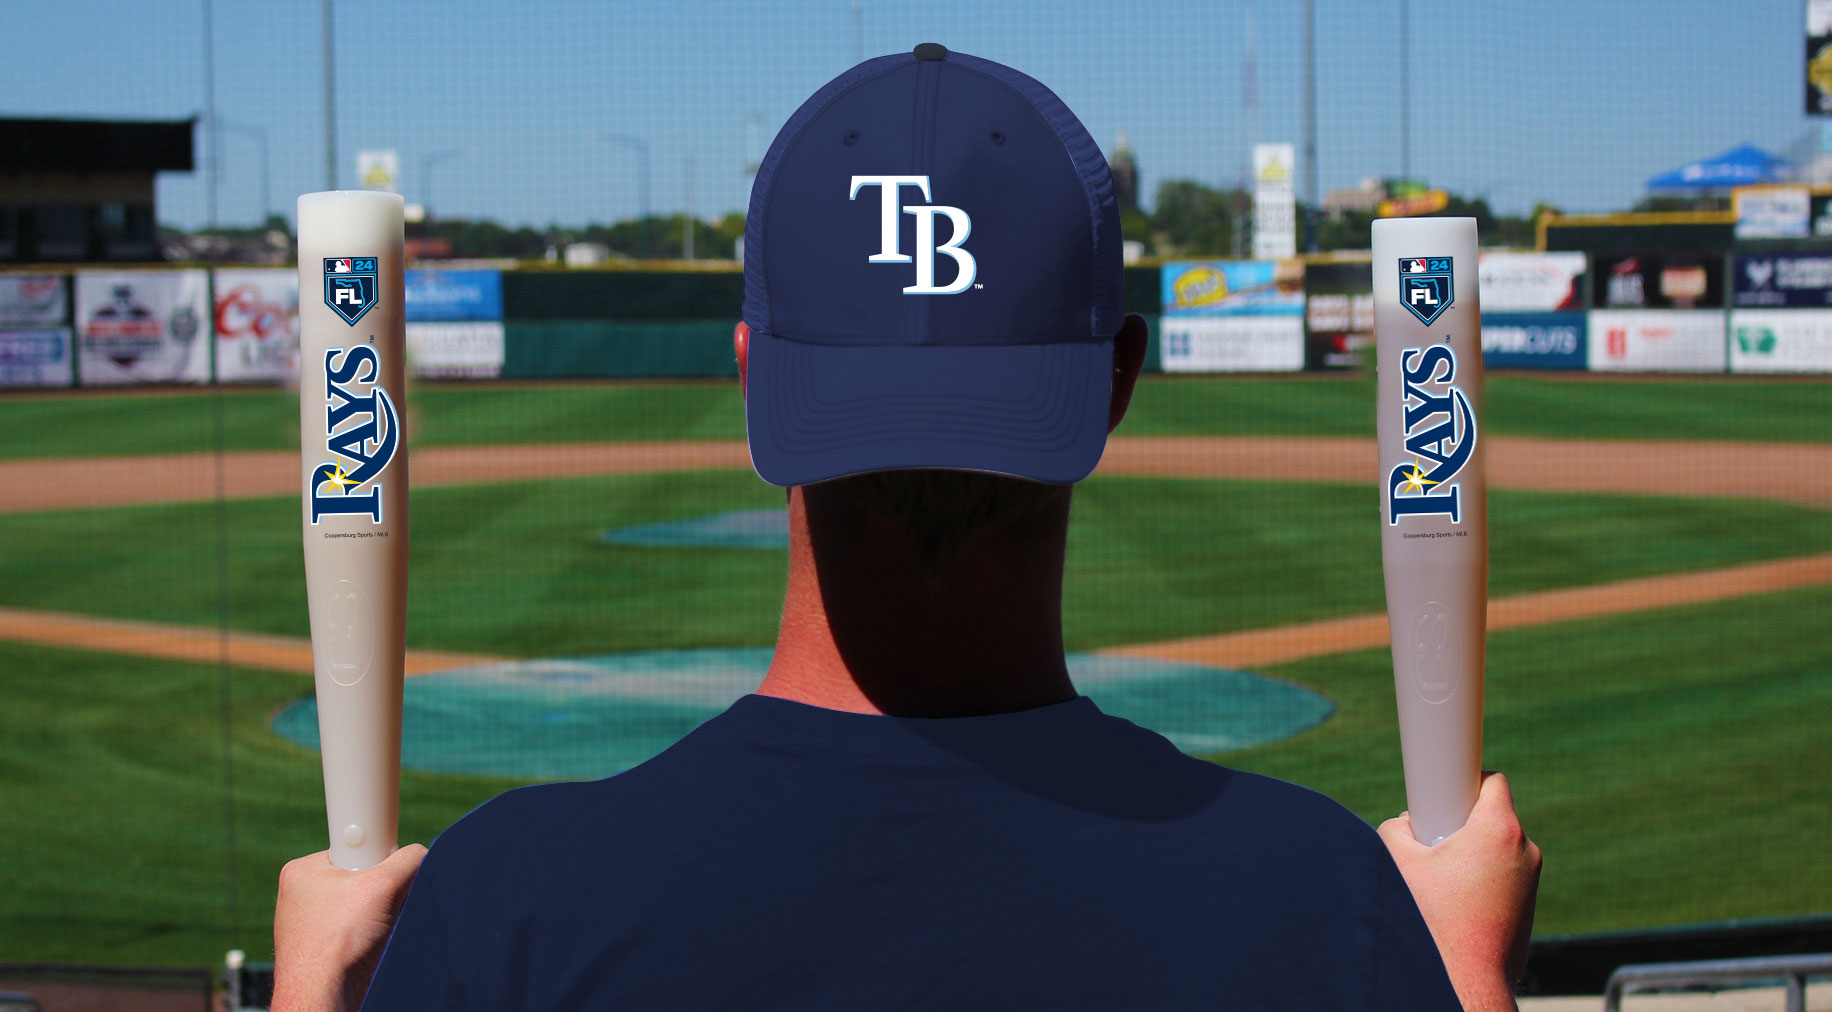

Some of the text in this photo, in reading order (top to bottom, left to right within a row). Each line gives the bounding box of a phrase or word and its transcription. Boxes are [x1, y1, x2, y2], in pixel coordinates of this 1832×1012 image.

[849, 175, 977, 295] TB
[355, 260, 374, 271] 24
[1430, 260, 1449, 271] 24
[335, 288, 363, 305] FL
[1410, 288, 1439, 305] FL
[310, 343, 400, 526] RAYS
[1388, 343, 1478, 526] RAYS
